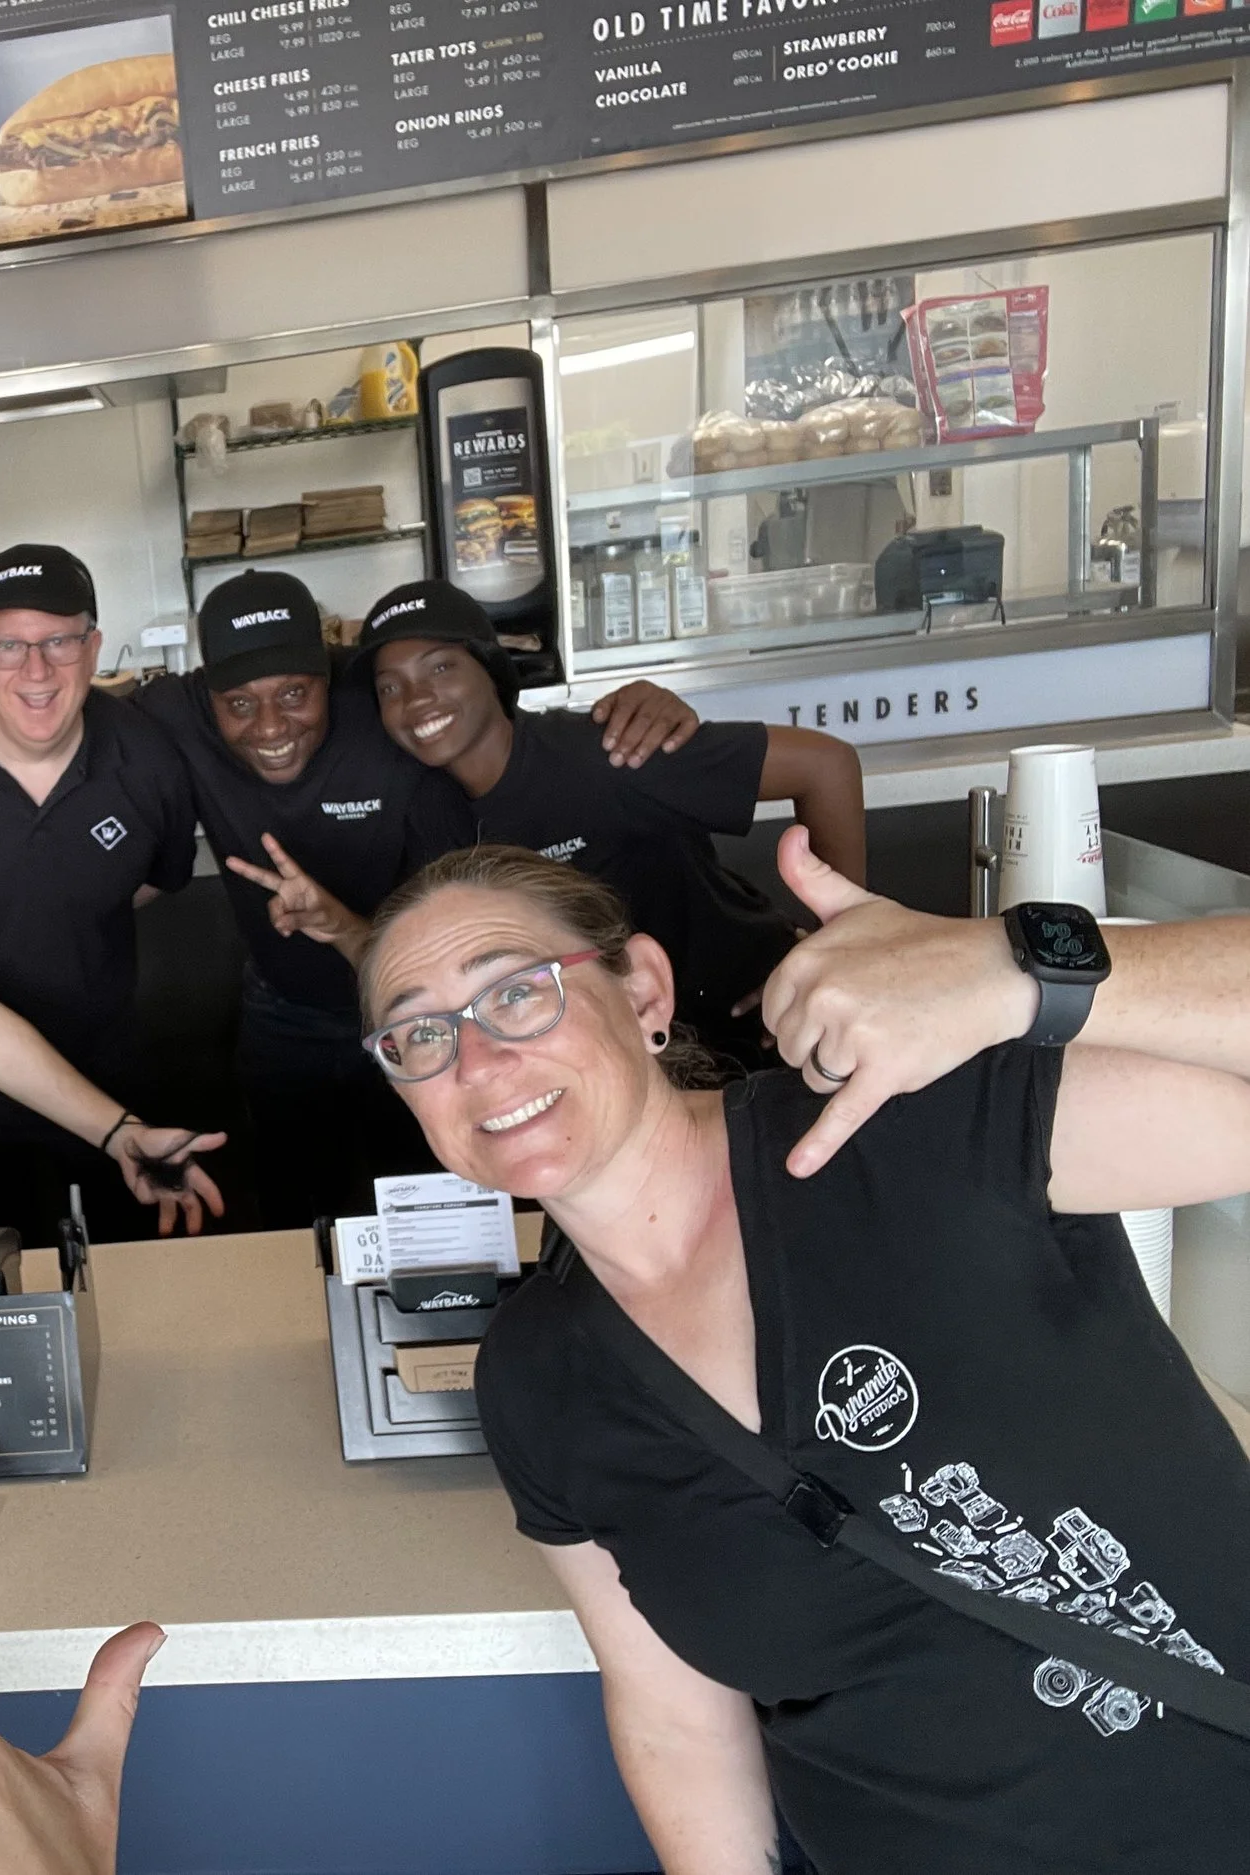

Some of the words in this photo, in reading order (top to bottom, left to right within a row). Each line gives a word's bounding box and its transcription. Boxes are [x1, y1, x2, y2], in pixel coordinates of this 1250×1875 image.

[207, 10, 246, 28] CHILI
[251, 1, 305, 21] CHEESE
[309, 0, 350, 12] FRIES
[389, 2, 411, 15] REG
[390, 16, 425, 31] LARGE
[593, 12, 645, 42] OLD
[660, 0, 728, 31] TIME
[209, 33, 231, 45] REG
[783, 26, 887, 56] STRAWBERRY
[210, 47, 245, 61] LARGE
[391, 48, 435, 66] TATER
[439, 41, 477, 58] TOTS
[836, 50, 898, 73] COOKIE
[214, 76, 267, 96] CHEESE
[271, 68, 311, 86] FRIES
[393, 72, 415, 83] REG
[595, 60, 662, 83] VANILLA
[394, 85, 429, 100] LARGE
[595, 82, 687, 109] CHOCOLATE
[215, 102, 237, 113] REG
[395, 113, 450, 133] ONION
[454, 104, 504, 124] RINGS
[216, 115, 250, 129] LARGE
[219, 142, 277, 162] FRENCH
[281, 134, 320, 152] FRIES
[397, 138, 419, 150] REG
[221, 167, 242, 178] REG
[222, 179, 256, 194] LARGE
[454, 433, 526, 457] REWARDS
[232, 608, 291, 630] WAYBACK
[372, 598, 426, 630] WAYBACK
[788, 686, 979, 728] TENDERS
[321, 798, 382, 814] WAYBACK
[420, 1294, 473, 1311] WAYBACK
[815, 1357, 901, 1442] Dynamite
[859, 1383, 907, 1427] STUDIOS
